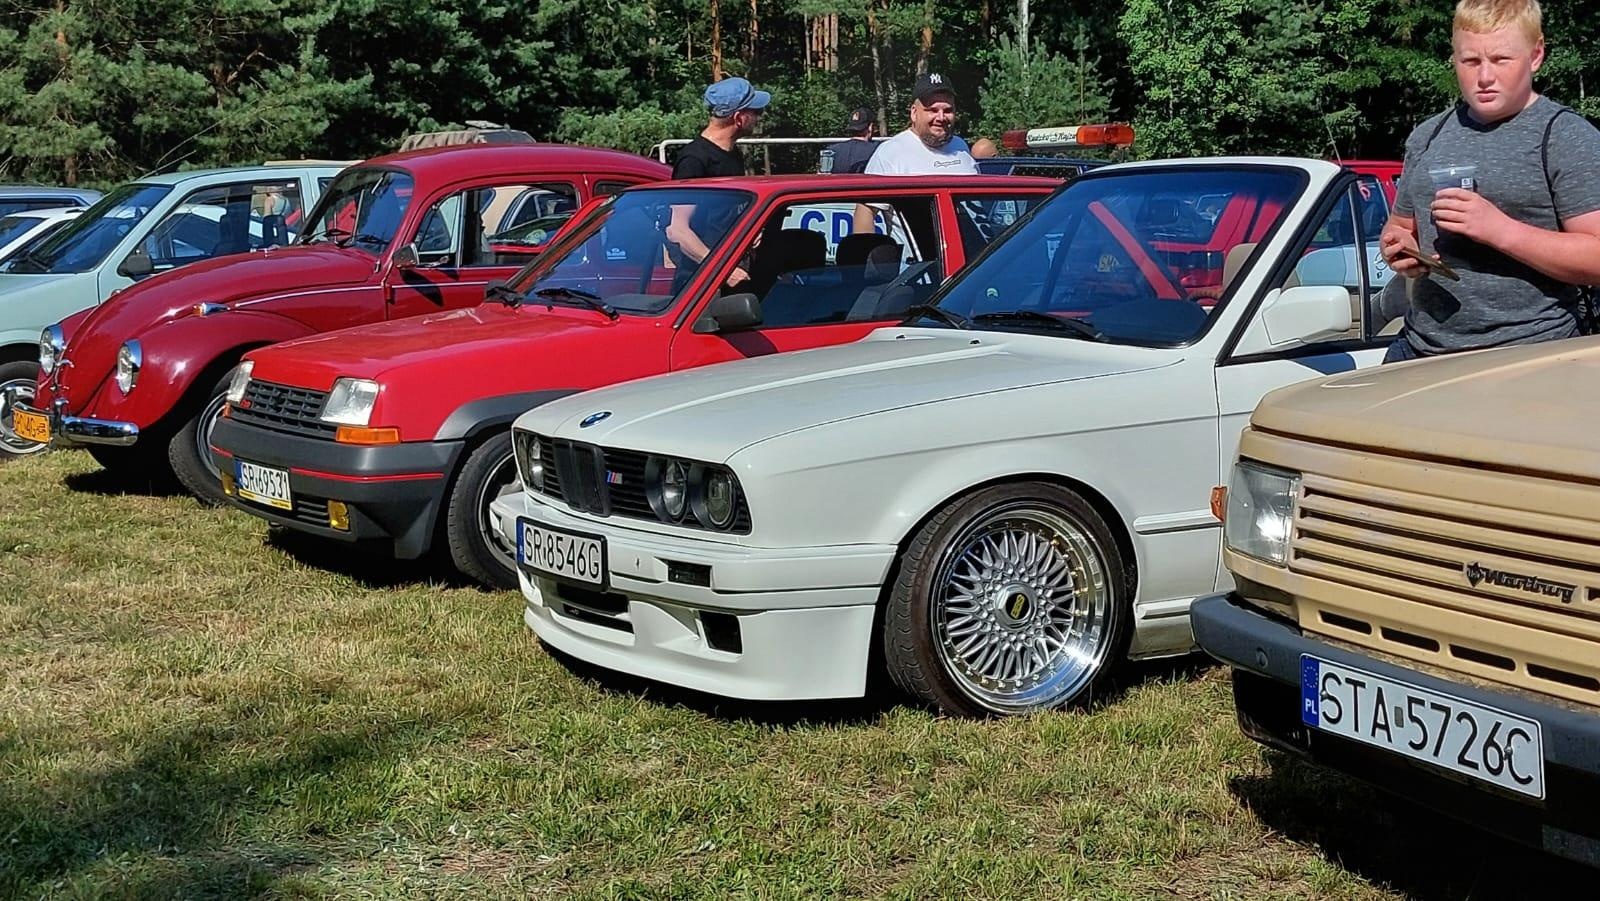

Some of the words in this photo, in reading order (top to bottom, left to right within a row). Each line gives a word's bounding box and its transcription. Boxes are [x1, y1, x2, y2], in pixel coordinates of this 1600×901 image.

[547, 534, 600, 579] 8546G
[1305, 699, 1318, 715] PL
[1320, 672, 1393, 744] STA
[1407, 695, 1534, 785] 5726C
